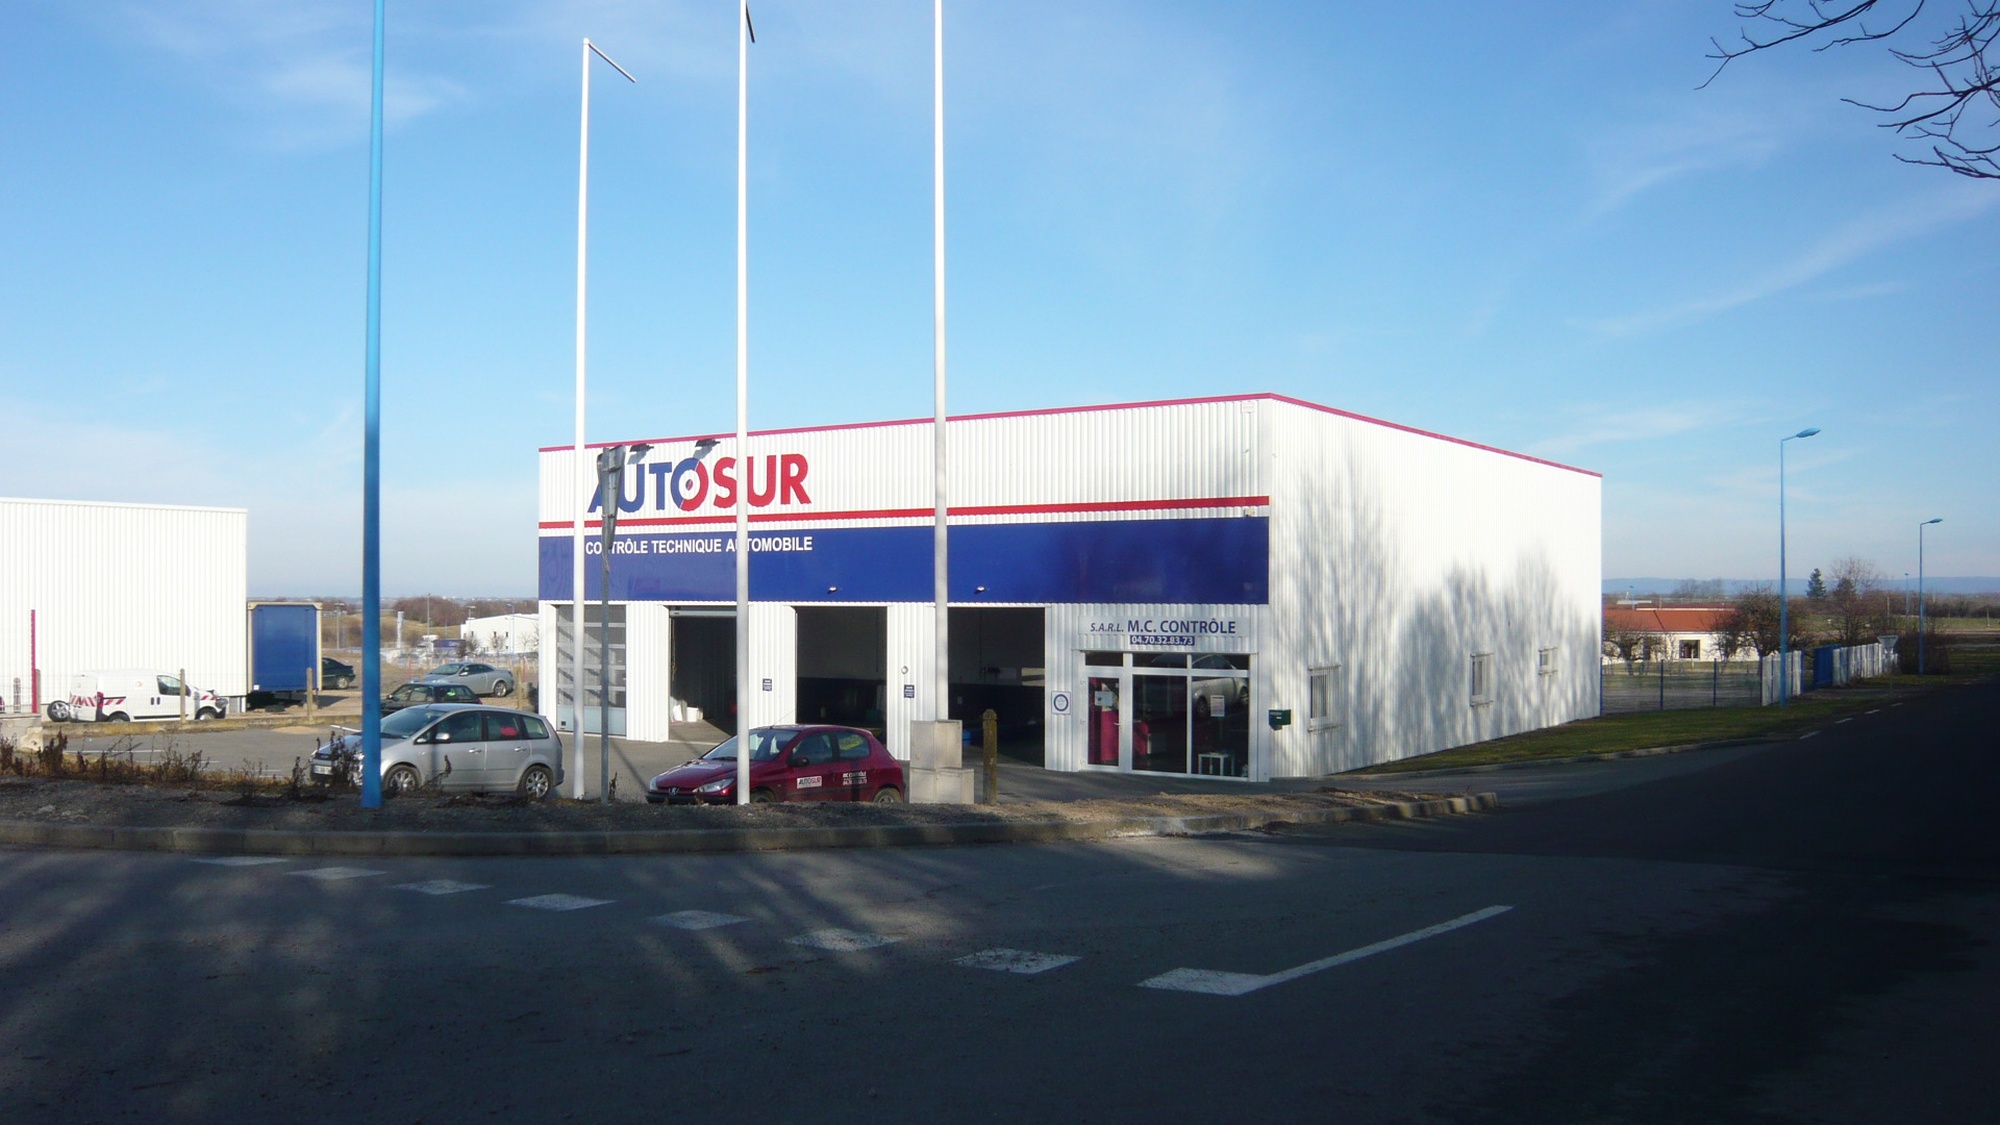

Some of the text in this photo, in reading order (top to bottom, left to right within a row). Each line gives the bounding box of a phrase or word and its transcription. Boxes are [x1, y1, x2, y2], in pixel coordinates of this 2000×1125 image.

[585, 536, 813, 554] COTRÔLE TECHNIQUE ATOMOBILE
[1090, 618, 1236, 634] S.A.R.L. M.C. CONTRÔLE
